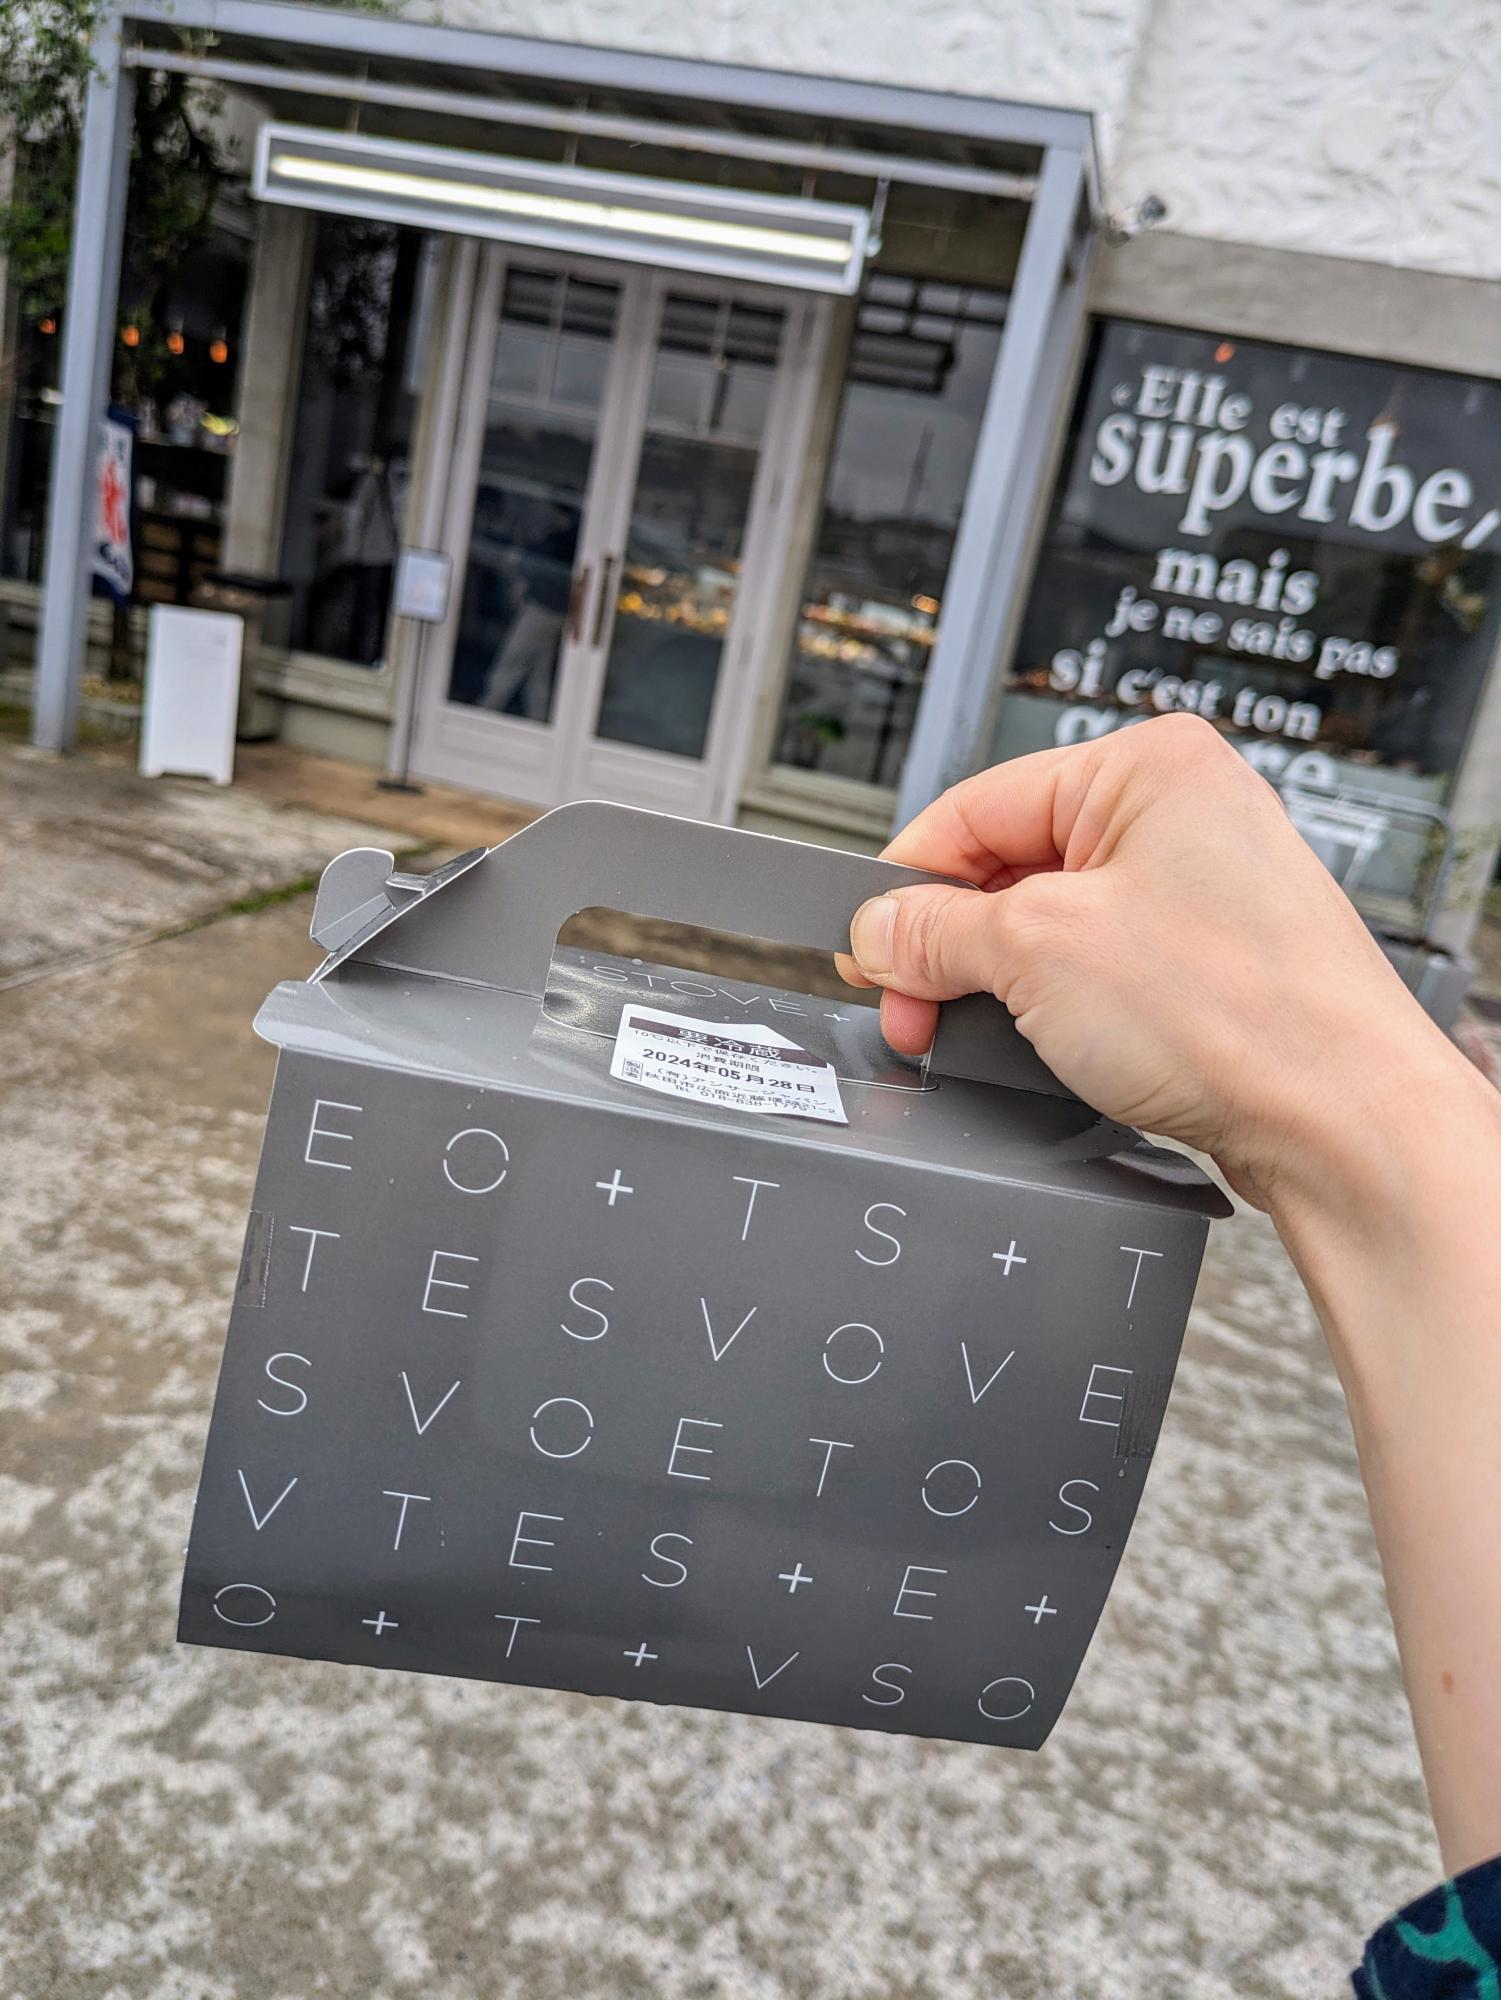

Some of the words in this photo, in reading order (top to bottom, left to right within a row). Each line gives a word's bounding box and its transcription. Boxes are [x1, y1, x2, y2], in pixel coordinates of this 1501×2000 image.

[1134, 364, 1252, 432] Elle
[1269, 401, 1347, 449] est
[1089, 413, 1501, 550] superbe,
[1151, 546, 1320, 615] mais
[1105, 585, 1159, 638] je
[1162, 604, 1224, 645] ne
[1226, 616, 1314, 662] sais
[1314, 635, 1399, 680] pas
[1048, 637, 1107, 698] si
[1115, 666, 1226, 721] c'est
[1232, 686, 1322, 742] ton
[642, 1048, 816, 1094] 2024年05月28日
